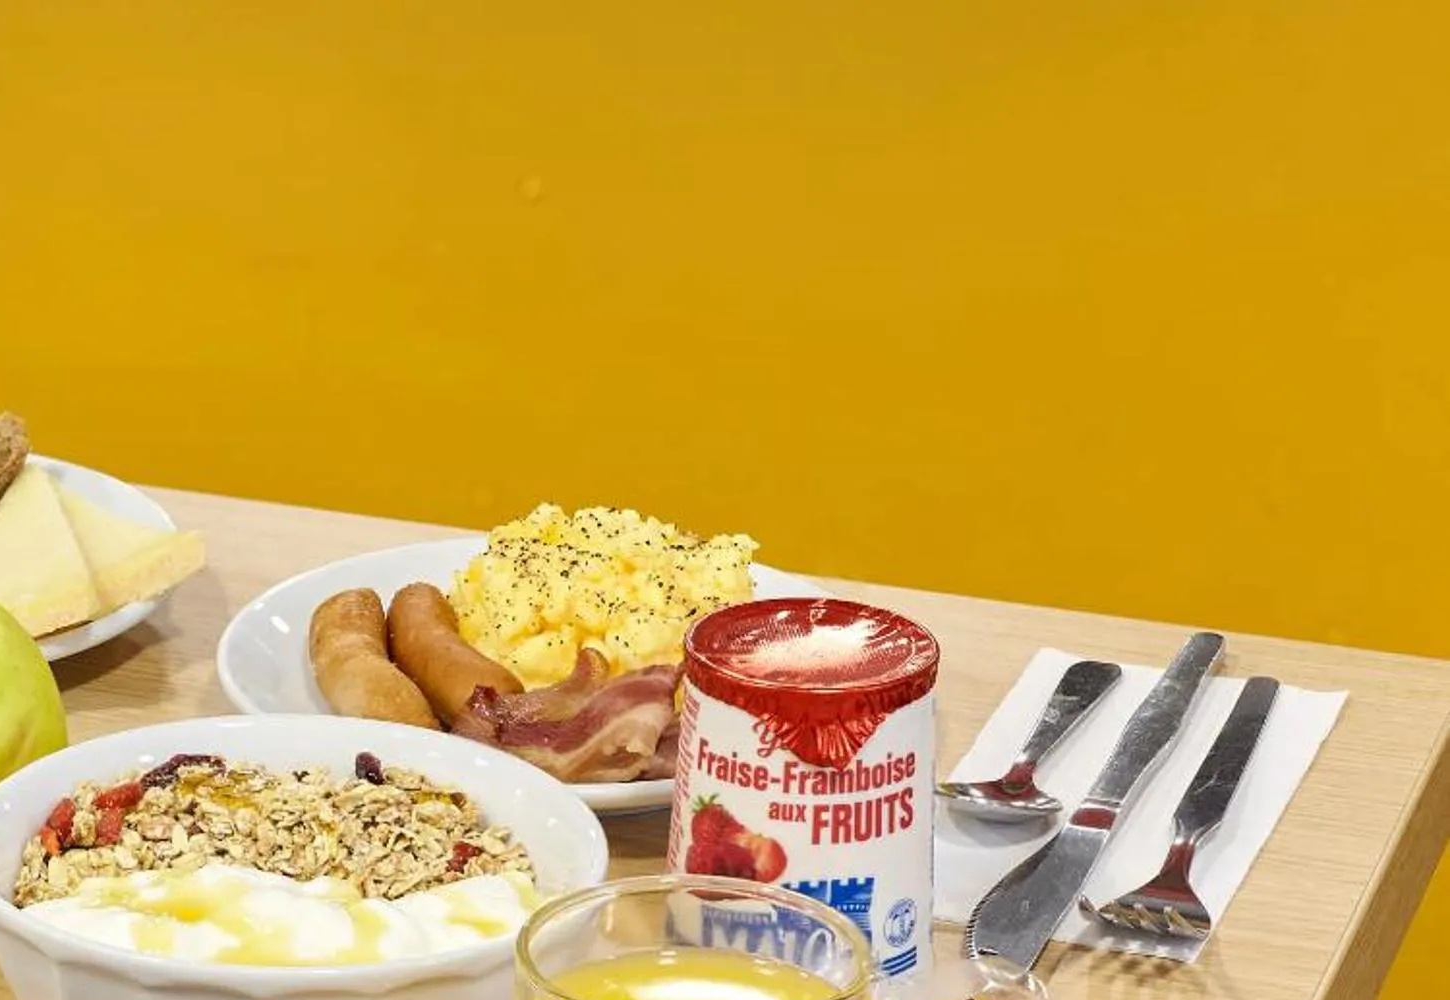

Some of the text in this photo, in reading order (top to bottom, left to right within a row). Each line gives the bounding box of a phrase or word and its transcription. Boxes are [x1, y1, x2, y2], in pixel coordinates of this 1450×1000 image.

[697, 737, 916, 797] Fraise-Framboise
[768, 787, 914, 846] aux FRUITS
